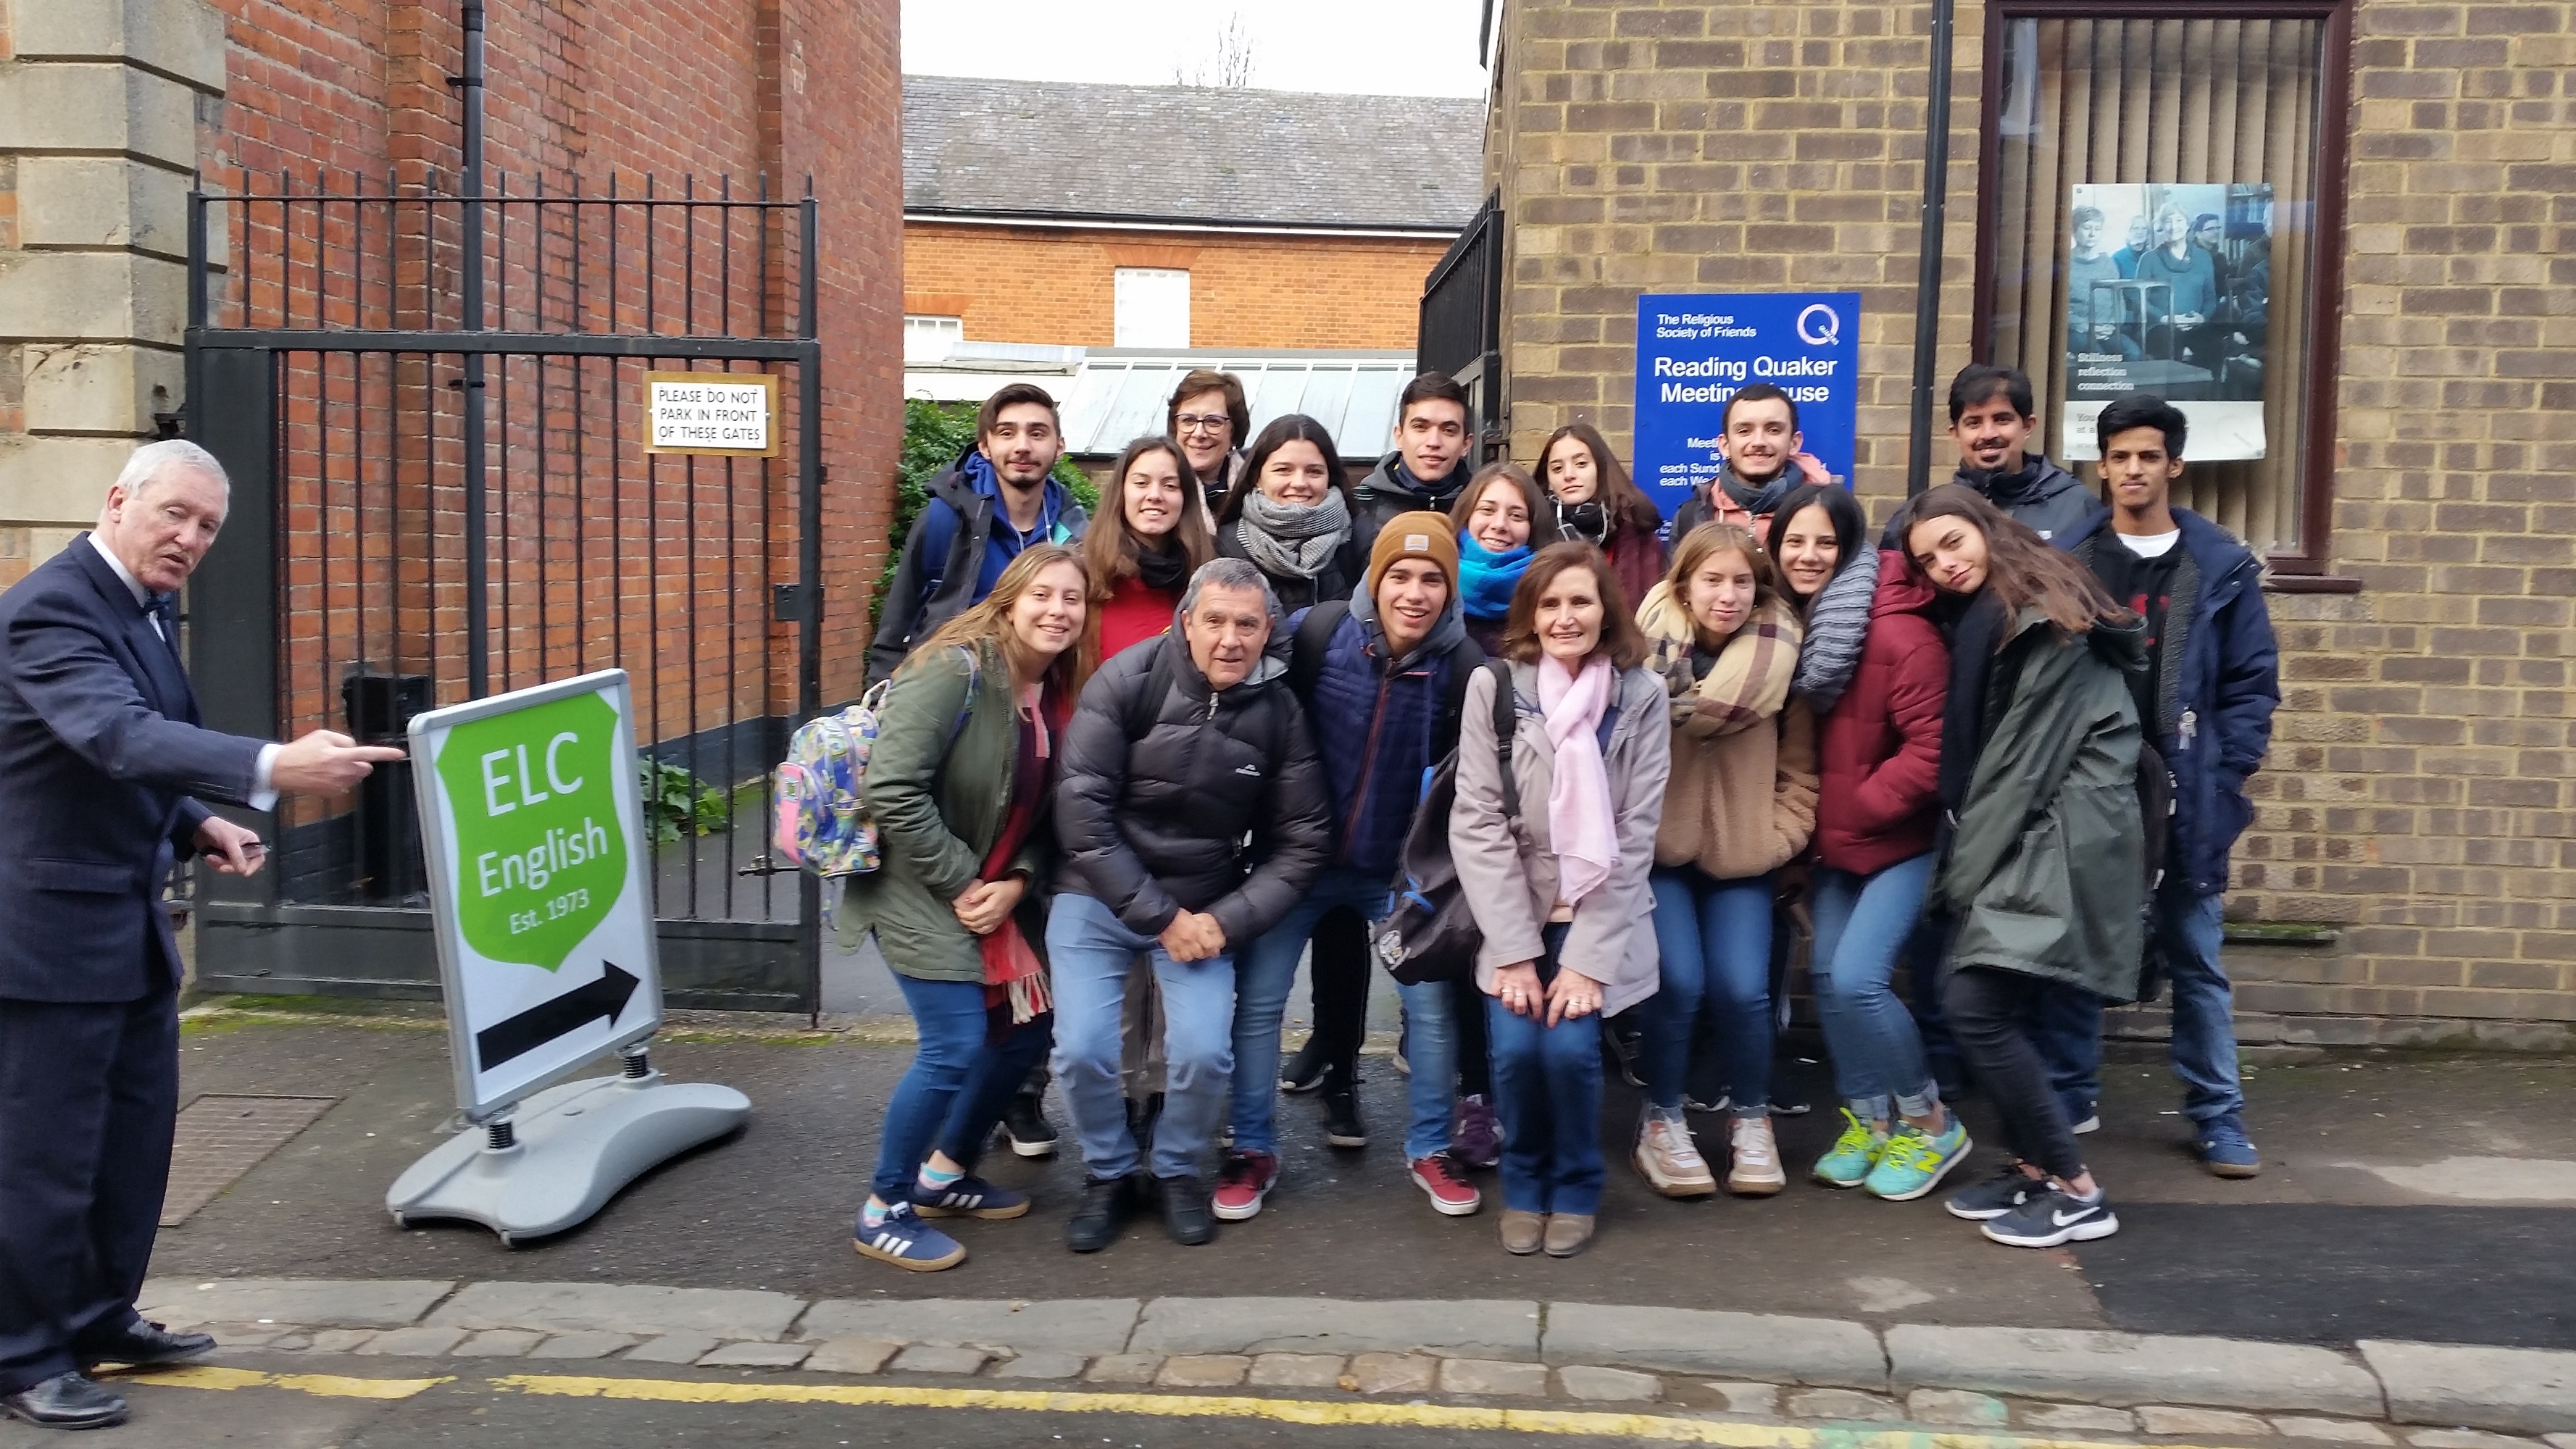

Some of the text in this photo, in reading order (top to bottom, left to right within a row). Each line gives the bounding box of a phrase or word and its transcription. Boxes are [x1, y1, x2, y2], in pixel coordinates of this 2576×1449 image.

[1657, 314, 1734, 326] The Religious
[1656, 326, 1756, 341] Society of Friends
[2077, 352, 2123, 362] Stillness
[1654, 356, 1838, 381] Reading Quaker
[2077, 367, 2127, 377] reflection
[2077, 380, 2135, 391] connection
[659, 390, 758, 404] PLEASE DO NOT
[1661, 383, 1743, 403] Meetin
[660, 408, 757, 422] PARK IN FRONT
[659, 426, 759, 440] OF THESE GATES
[1710, 451, 1721, 461] is
[1659, 463, 1720, 474] each Sund
[1659, 476, 1688, 486] each
[481, 732, 583, 817] ELC
[478, 817, 608, 898] English
[509, 888, 590, 935] Est. 1973
